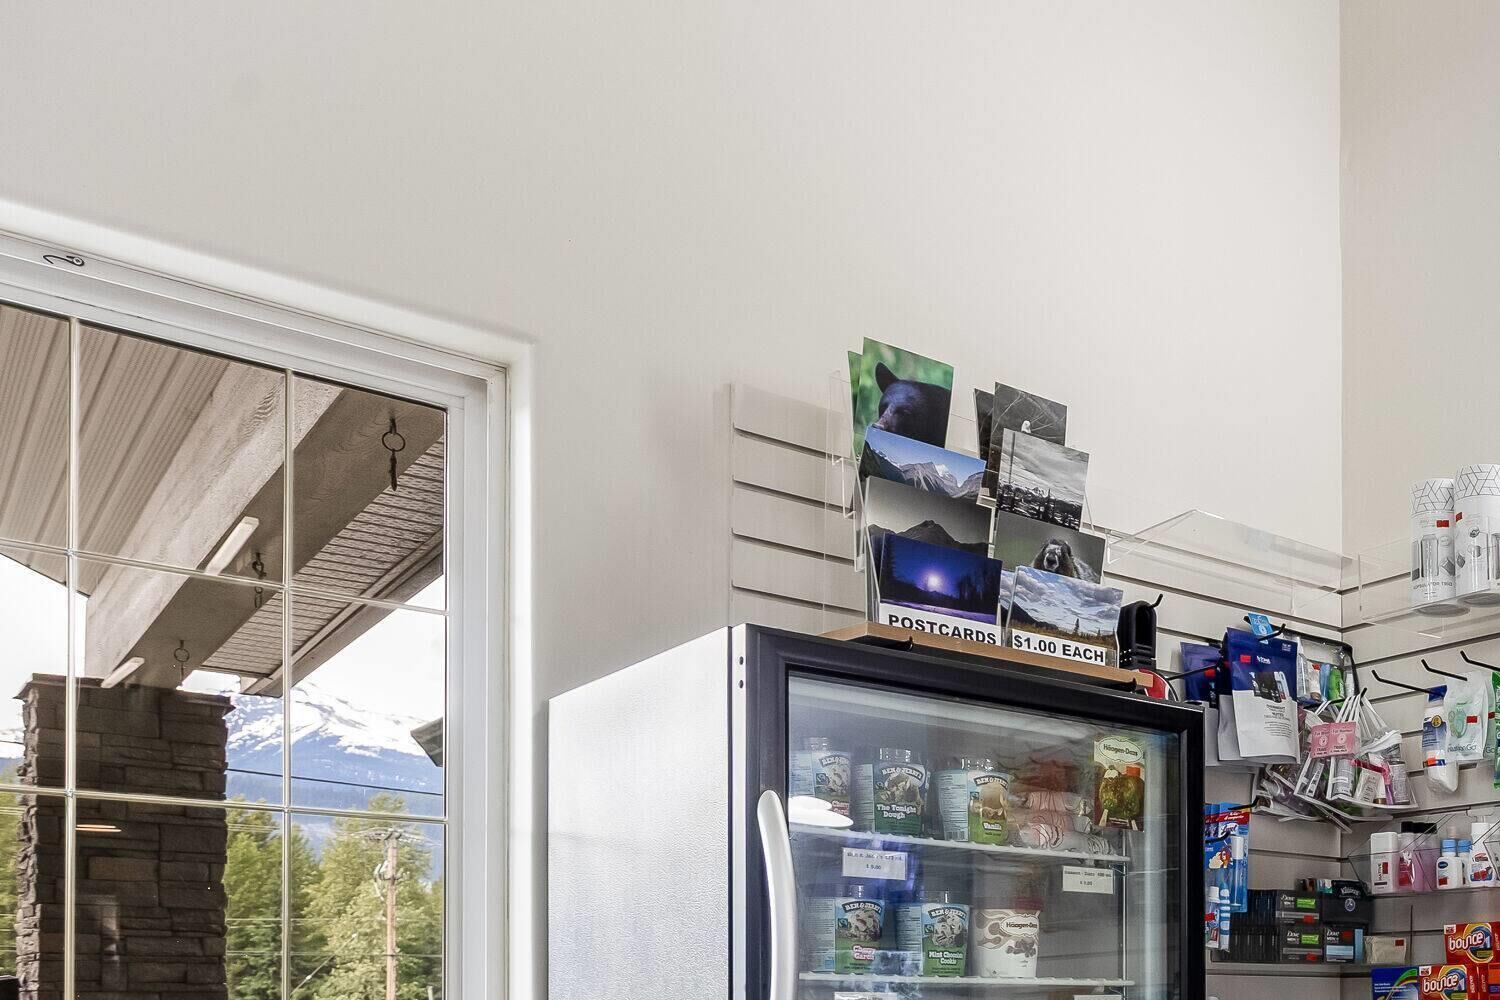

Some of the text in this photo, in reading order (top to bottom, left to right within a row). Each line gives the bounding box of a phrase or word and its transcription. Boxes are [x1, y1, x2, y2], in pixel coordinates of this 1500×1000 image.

[888, 614, 997, 645] POSTCARDS
[1014, 634, 1104, 663] $1.00 EACH
[1103, 743, 1138, 757] Häagen-Dazs
[976, 777, 989, 785] BEN
[891, 805, 917, 814] Tonight
[883, 811, 905, 819] Dough
[845, 902, 859, 911] BEN
[930, 908, 945, 917] BEN
[1449, 932, 1484, 950] bounce
[928, 951, 942, 959] Mint
[940, 957, 957, 965] Cookie
[1423, 974, 1458, 993] bounce
